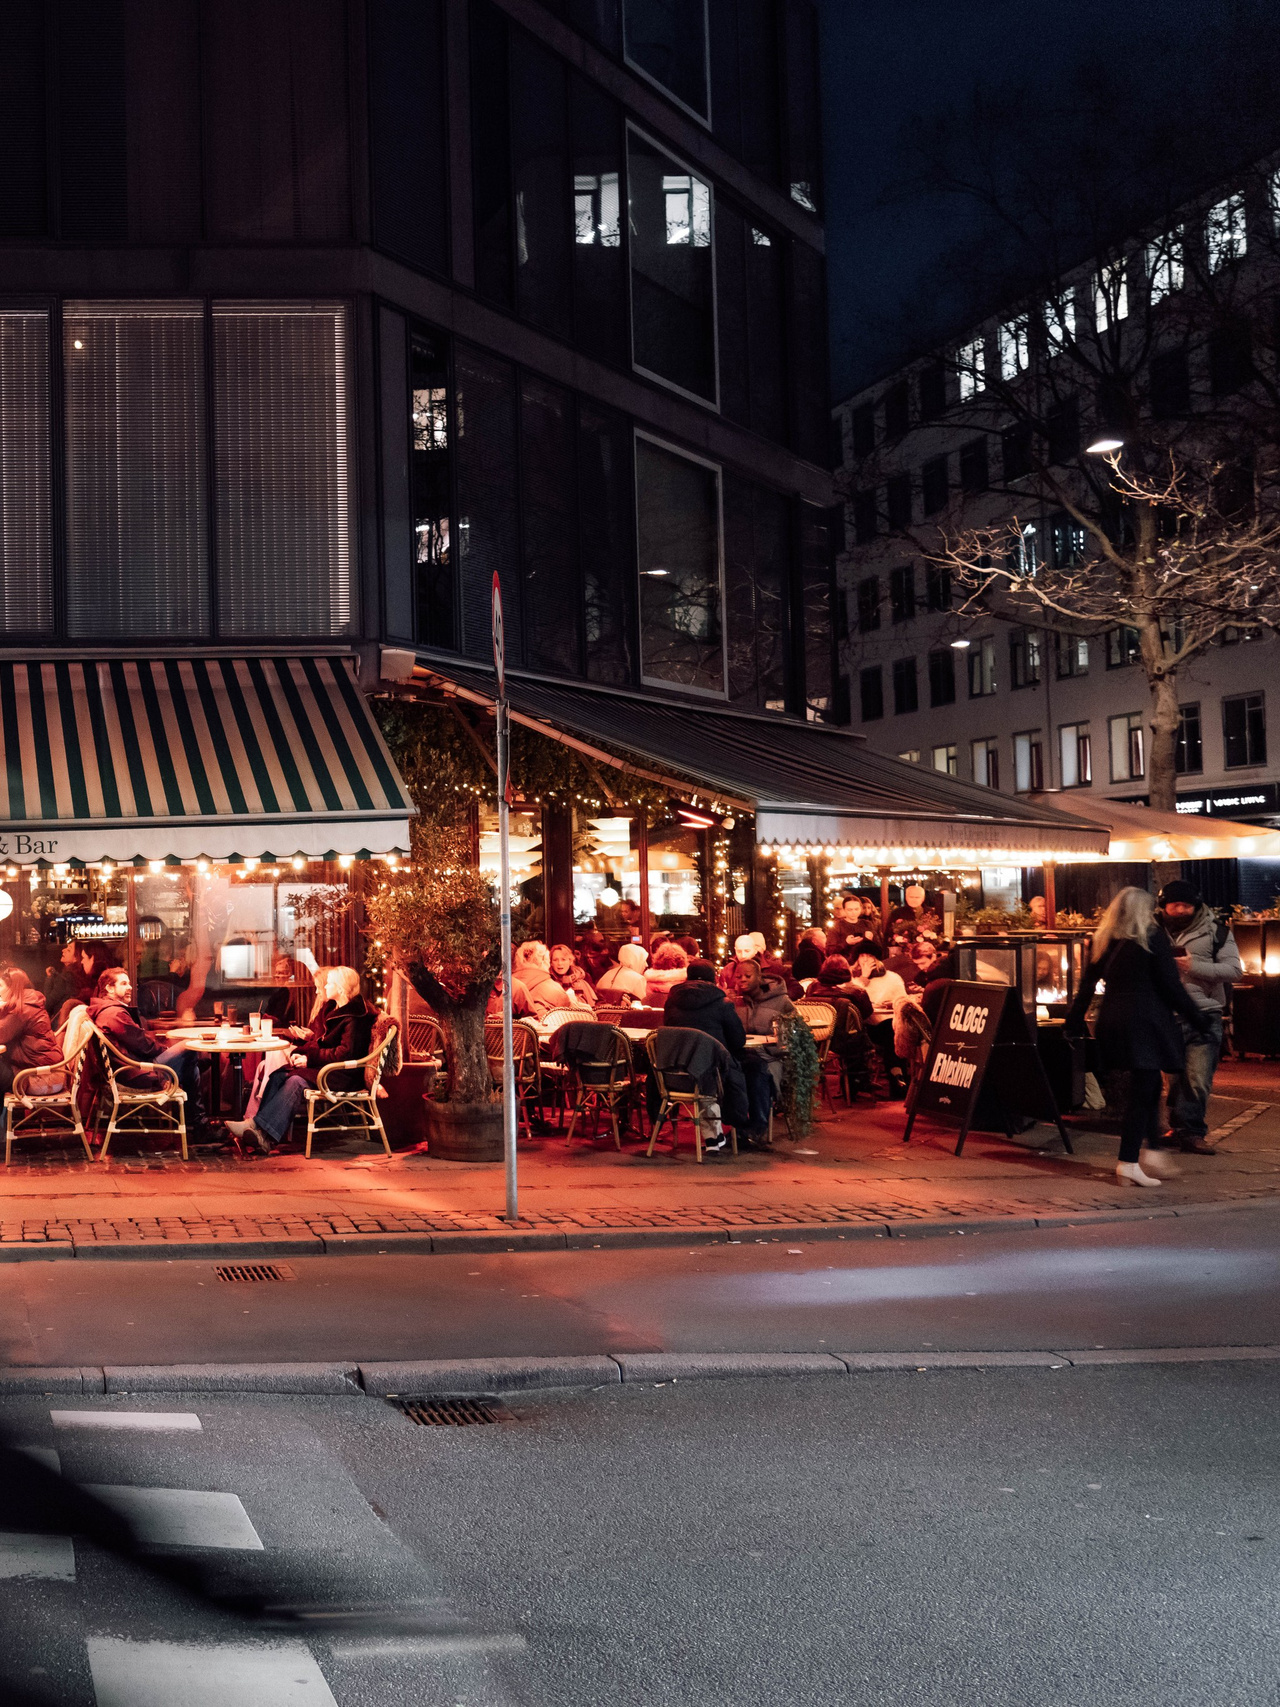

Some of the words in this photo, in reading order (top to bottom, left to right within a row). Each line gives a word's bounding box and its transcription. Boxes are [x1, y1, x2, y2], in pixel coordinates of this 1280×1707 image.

[14, 834, 59, 855] Bar
[949, 1003, 989, 1035] GLØGG
[929, 1052, 977, 1089] Æbleskiver
